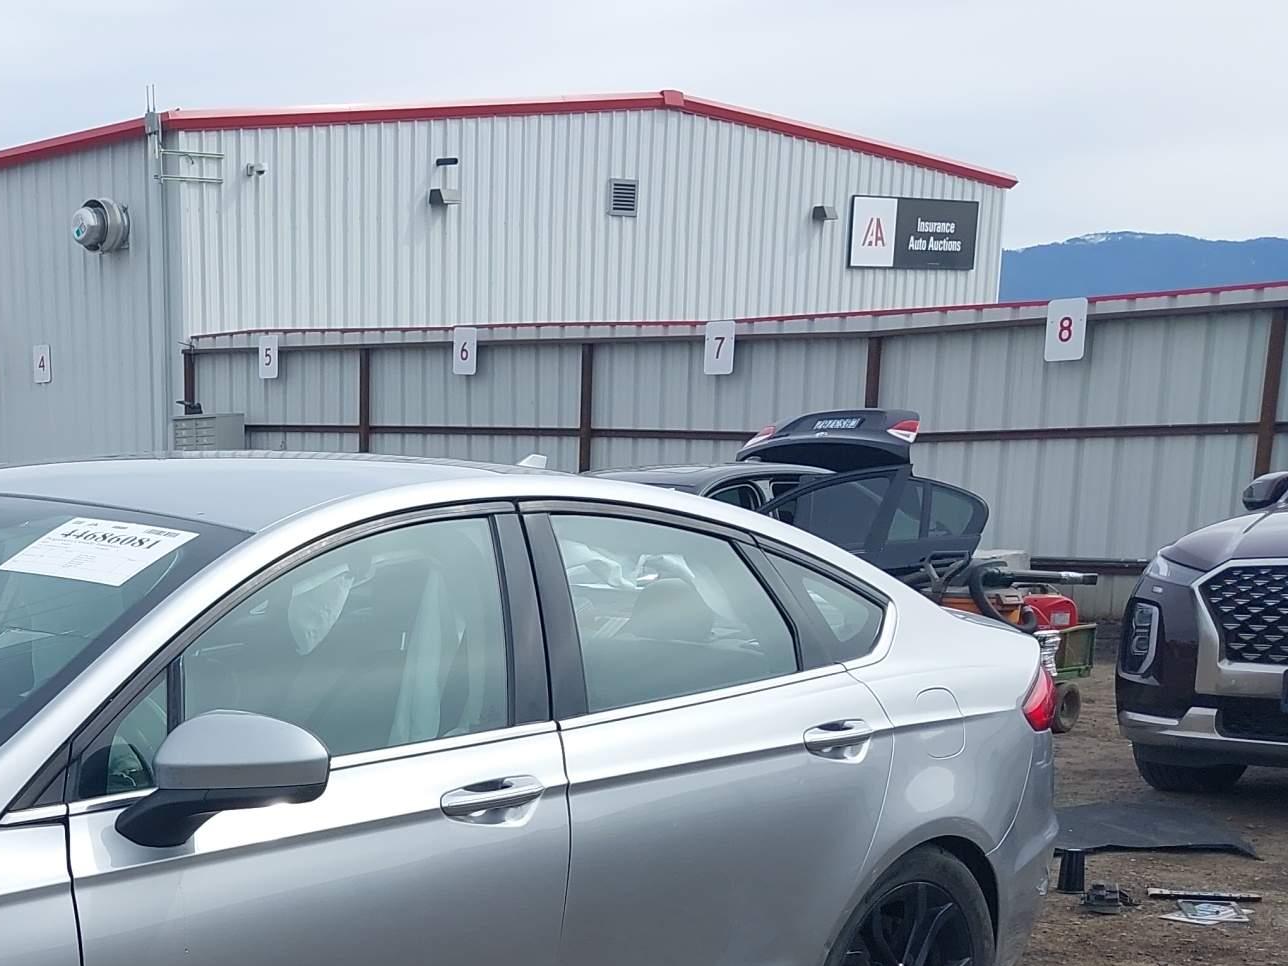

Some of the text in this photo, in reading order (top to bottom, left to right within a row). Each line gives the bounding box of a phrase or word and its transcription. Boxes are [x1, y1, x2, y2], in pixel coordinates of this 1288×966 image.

[916, 217, 956, 233] Insurance
[908, 235, 962, 252] Auto Auctions
[1058, 316, 1073, 343] 8
[264, 348, 273, 367] 5
[460, 341, 469, 361] 6
[714, 336, 725, 360] 7
[38, 355, 46, 372] 4
[61, 528, 161, 550] 44686081
